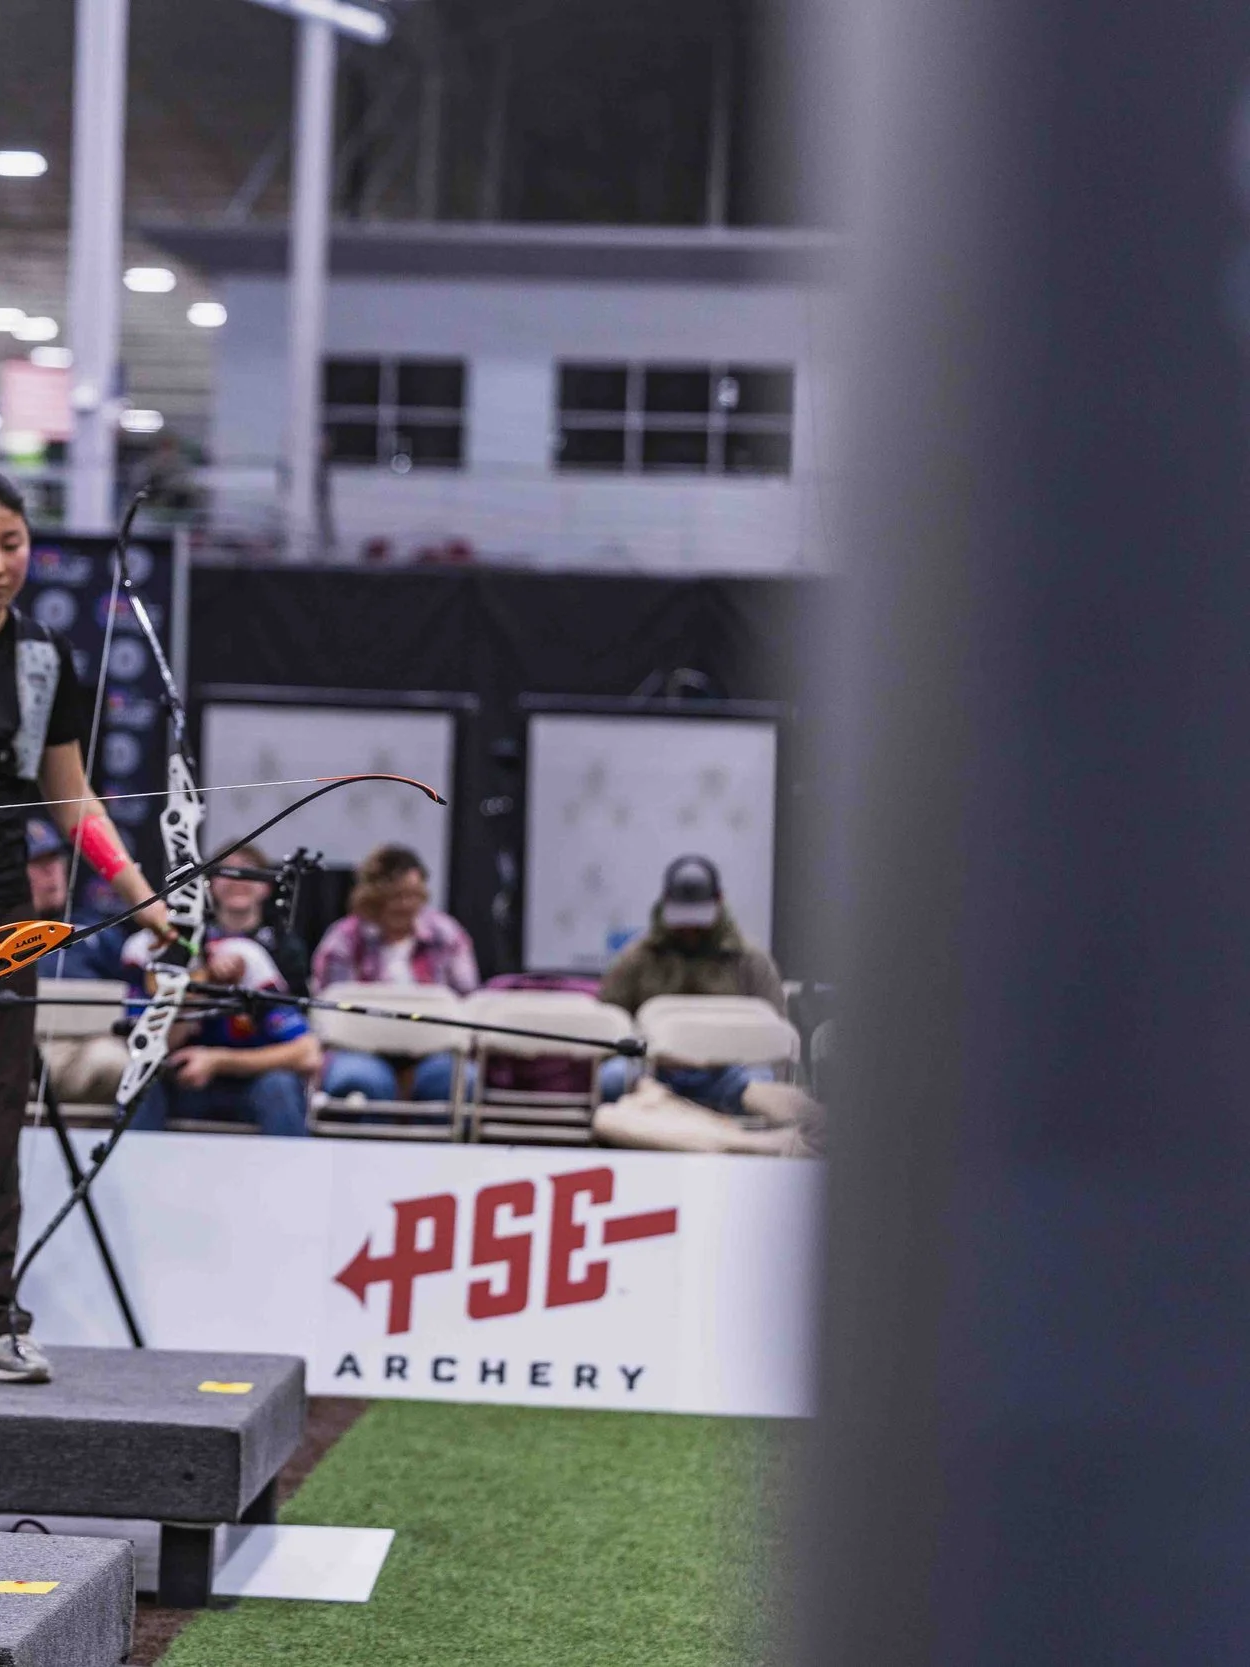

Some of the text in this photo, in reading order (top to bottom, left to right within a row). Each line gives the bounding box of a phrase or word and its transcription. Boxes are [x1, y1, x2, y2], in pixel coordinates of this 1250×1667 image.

[15, 934, 42, 949] HOYT
[386, 1167, 616, 1336] PSE
[334, 1353, 645, 1391] ARCHERY
